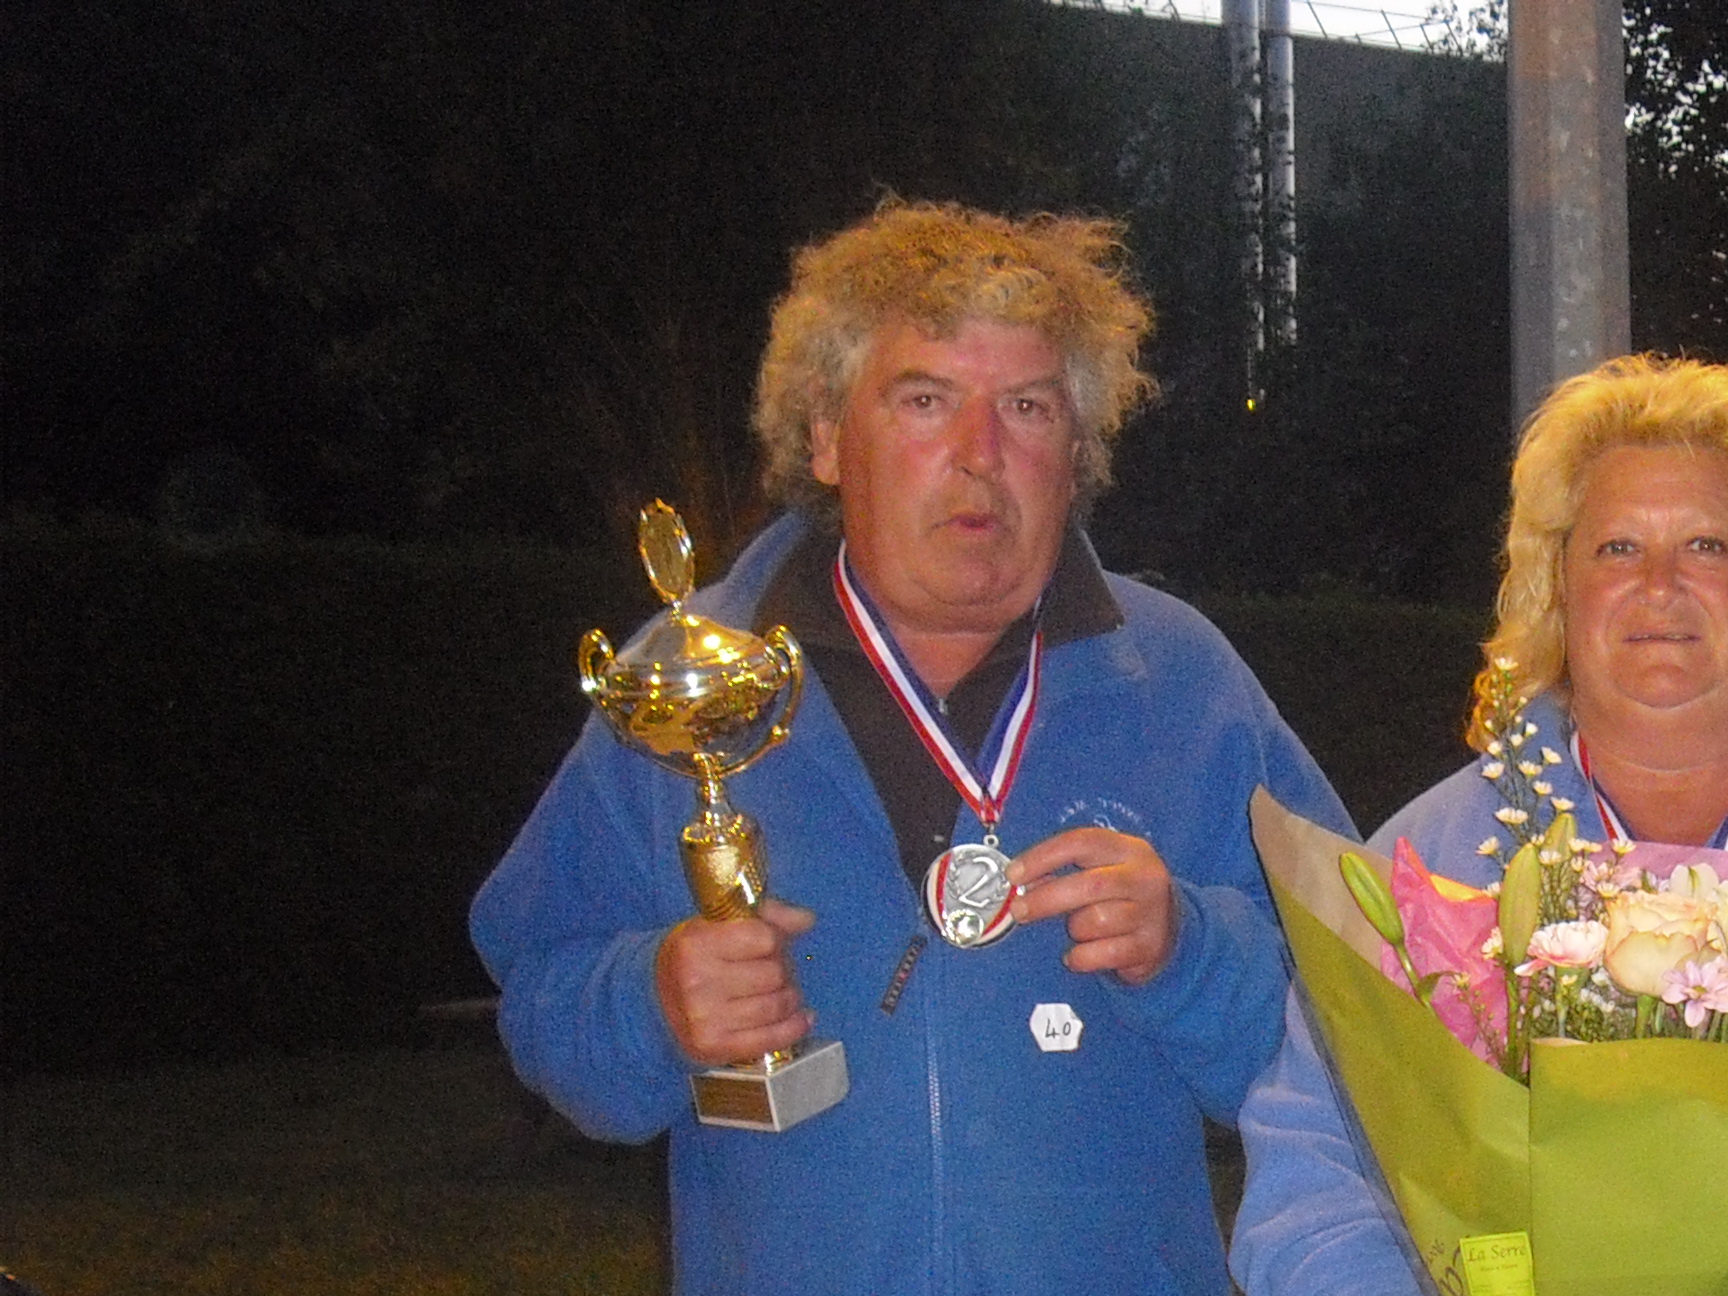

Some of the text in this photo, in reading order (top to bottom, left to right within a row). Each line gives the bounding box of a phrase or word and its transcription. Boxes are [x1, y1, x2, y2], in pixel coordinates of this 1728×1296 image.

[1044, 1017, 1072, 1039] 40
[1467, 1244, 1527, 1262] La Serre
